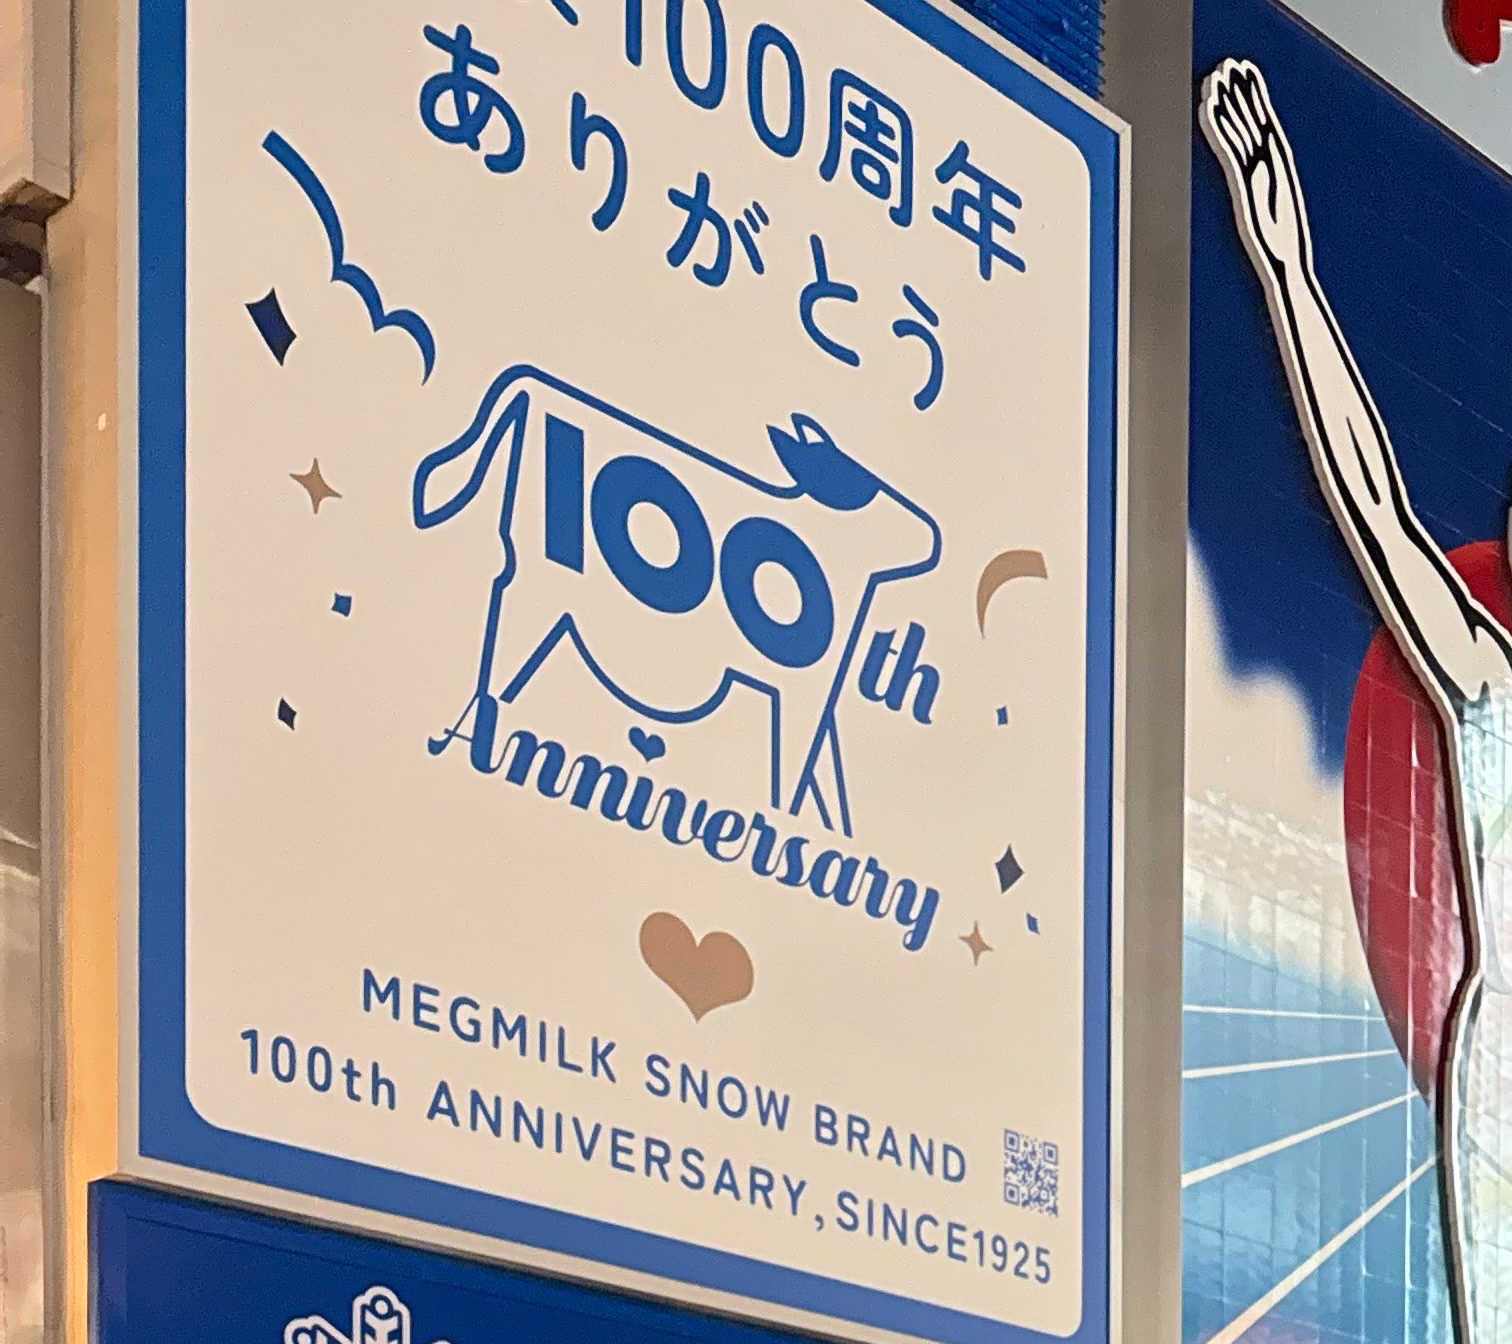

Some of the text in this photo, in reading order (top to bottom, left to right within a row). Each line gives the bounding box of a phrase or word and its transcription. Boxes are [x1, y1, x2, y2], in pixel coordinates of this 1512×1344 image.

[419, 24, 942, 411] ありがとう
[427, 692, 941, 952] Anniversary
[240, 1027, 399, 1113] 100th
[362, 968, 968, 1184] MEGMILK SNOW BRAND
